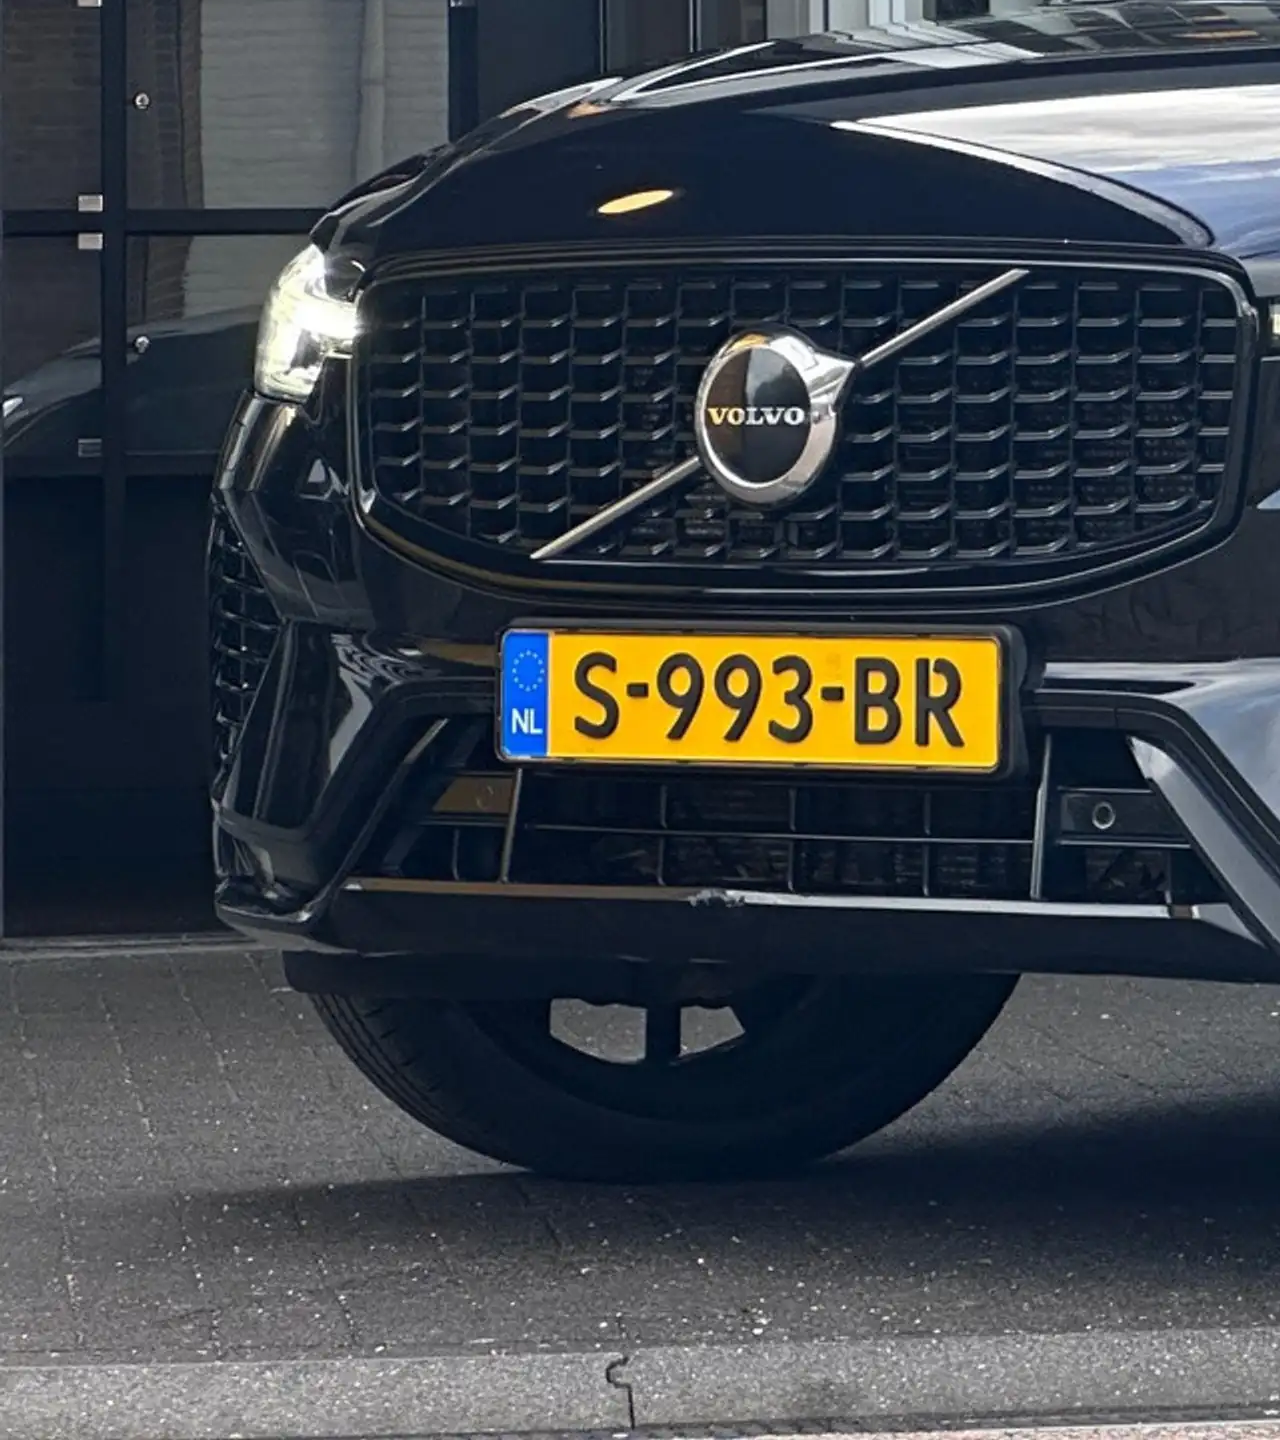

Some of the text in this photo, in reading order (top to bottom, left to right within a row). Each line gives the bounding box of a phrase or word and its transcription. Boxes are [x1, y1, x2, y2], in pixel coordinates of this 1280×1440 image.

[707, 405, 805, 427] VOLVO
[511, 651, 965, 747] NL S-993-BR
